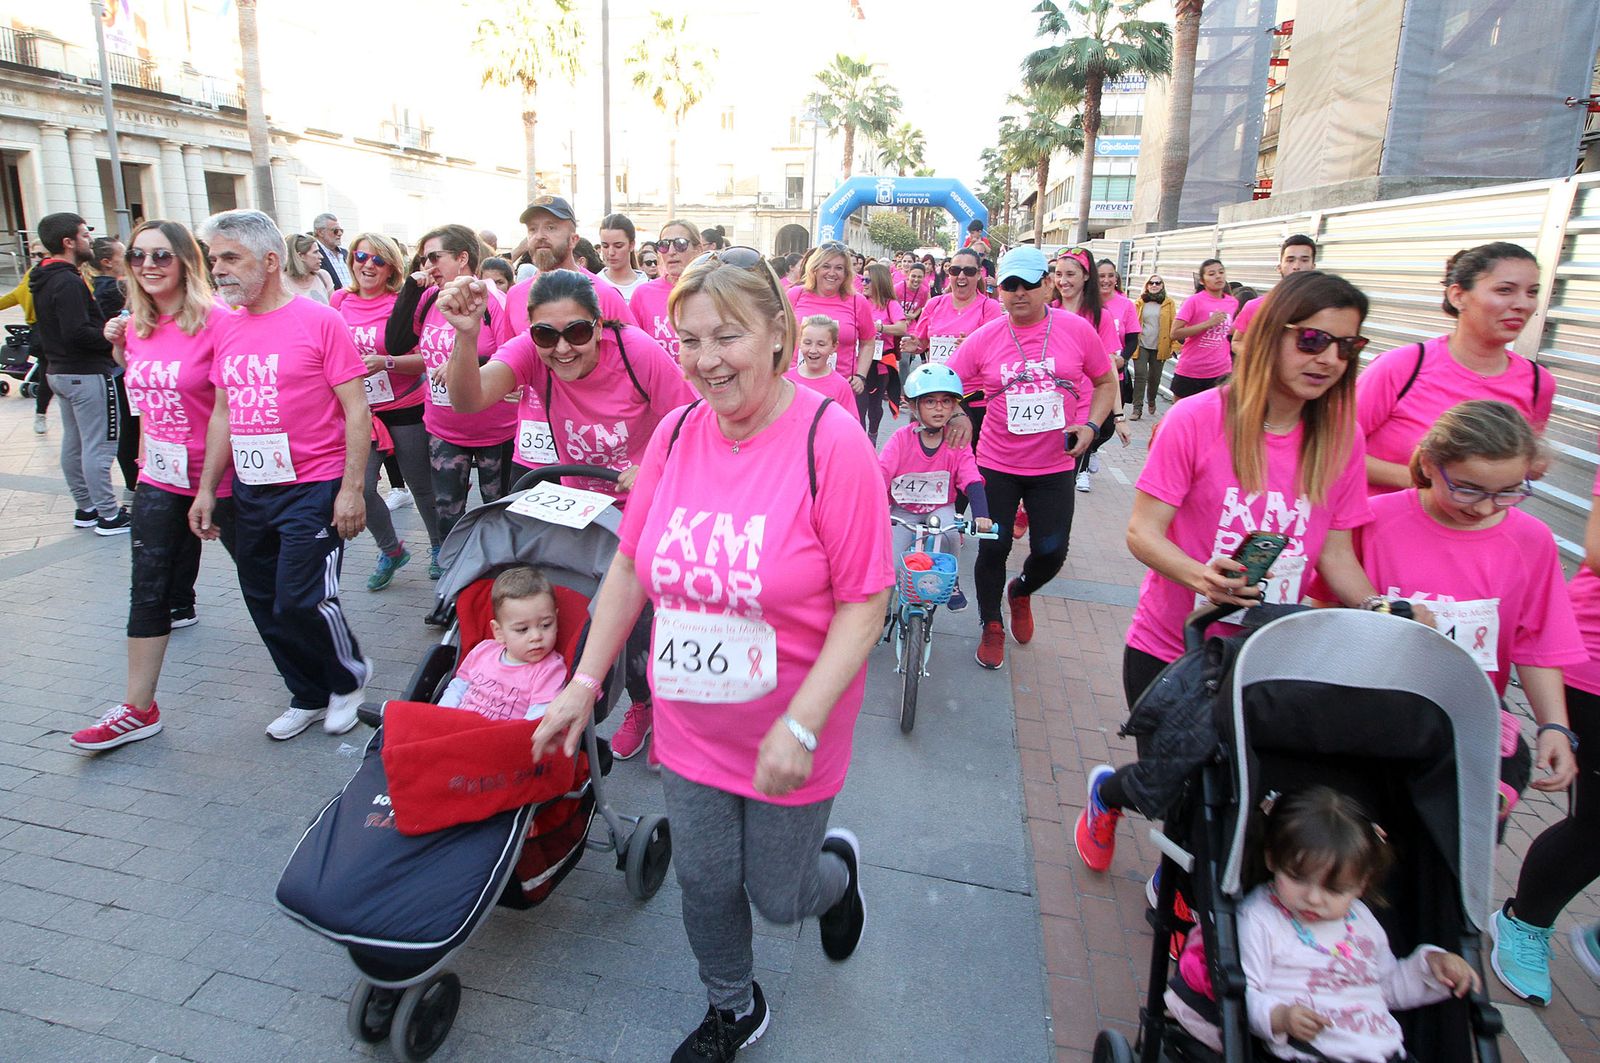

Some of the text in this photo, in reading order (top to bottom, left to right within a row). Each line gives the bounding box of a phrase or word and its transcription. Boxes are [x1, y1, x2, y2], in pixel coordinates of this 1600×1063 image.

[81, 104, 179, 128] AYUTAMIENTO
[1100, 142, 1140, 152] mediolan
[829, 188, 856, 214] DEPORTES
[950, 191, 976, 218] DEPORTES
[349, 326, 377, 347] M
[222, 354, 279, 385] KM
[420, 349, 450, 366] PO
[127, 360, 181, 388] KM
[129, 388, 183, 410] POR
[227, 386, 279, 408] POR
[1010, 405, 1044, 421] 749
[522, 432, 554, 450] 352
[564, 420, 629, 452] KM
[524, 491, 576, 512] 623
[1219, 487, 1312, 536] KM
[656, 506, 767, 570] KM
[651, 557, 762, 613] POR
[658, 638, 728, 675] 436
